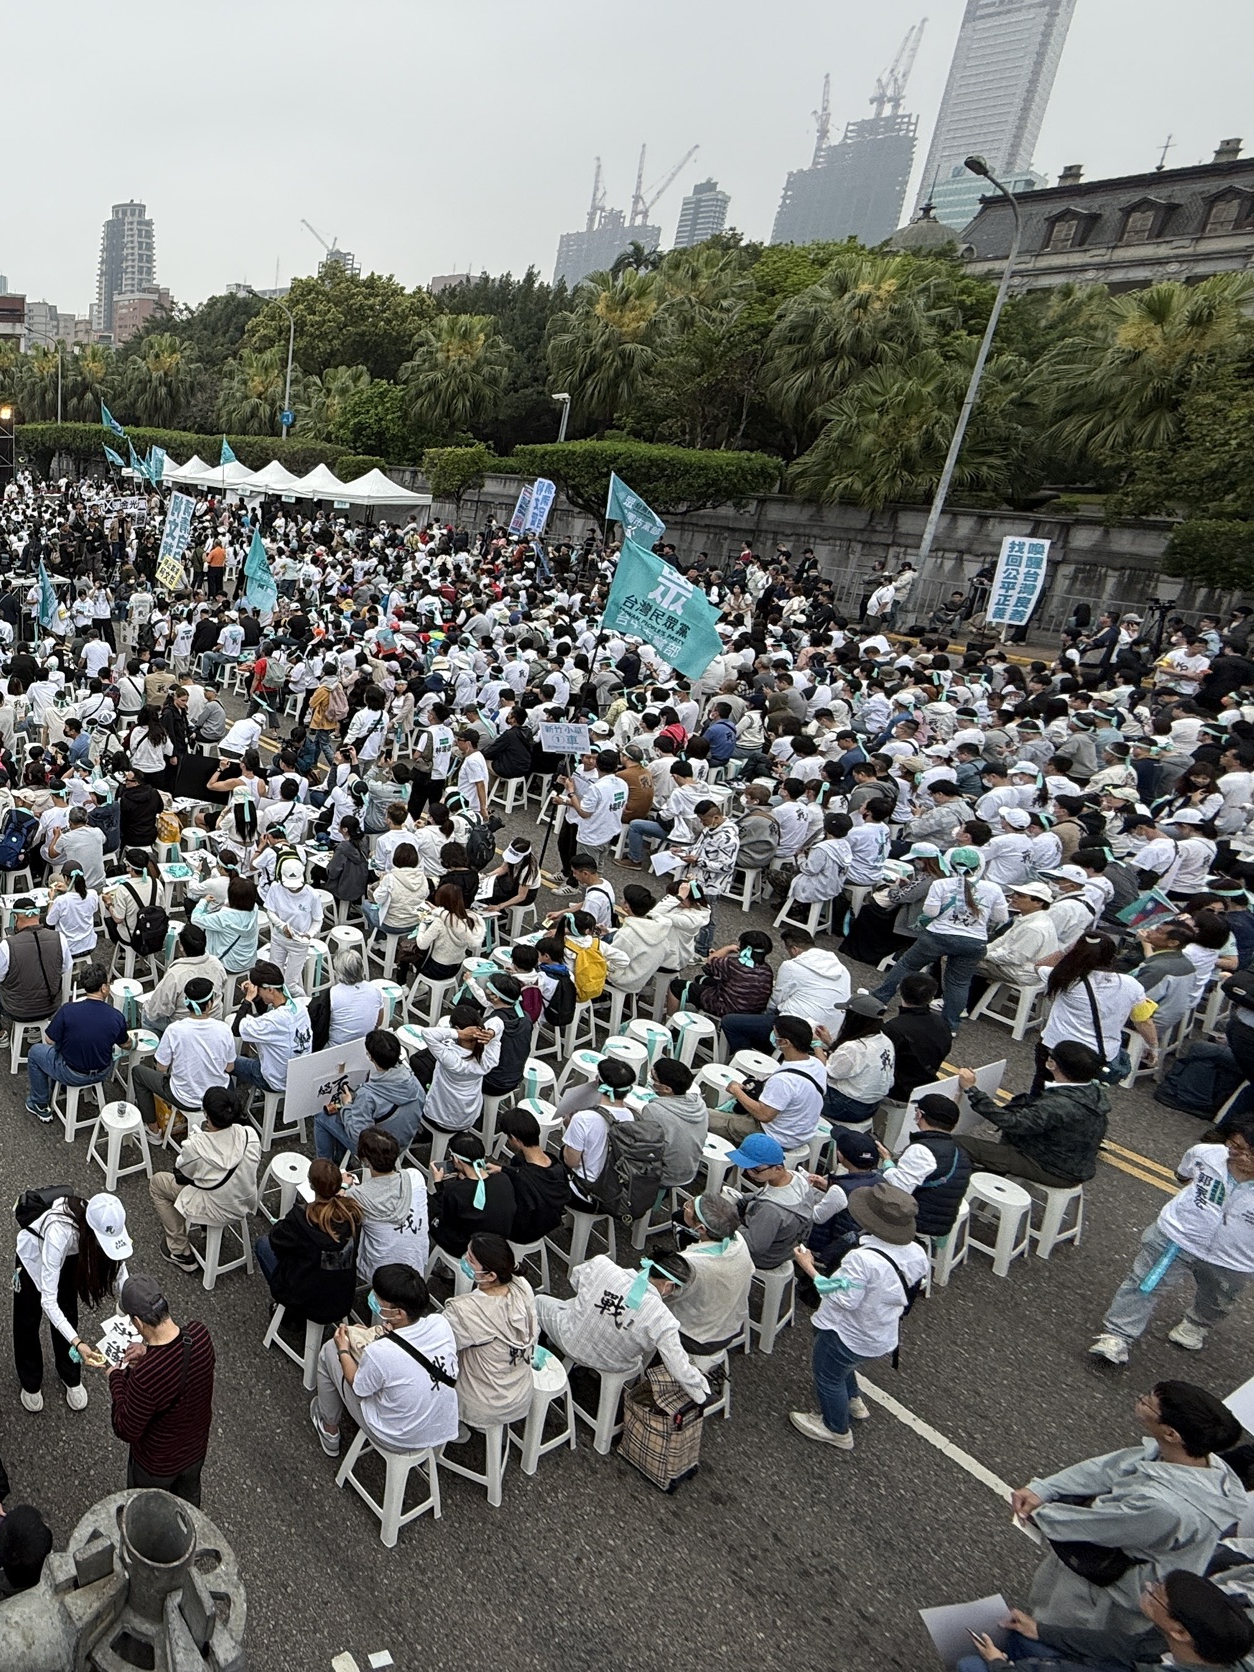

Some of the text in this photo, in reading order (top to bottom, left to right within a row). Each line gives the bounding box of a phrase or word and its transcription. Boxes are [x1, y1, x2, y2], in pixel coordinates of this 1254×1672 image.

[992, 540, 1026, 620] 找回公平正義
[623, 594, 691, 639] 台灣民眾黨
[666, 632, 685, 646] PARTY
[594, 1290, 635, 1331] 戰!
